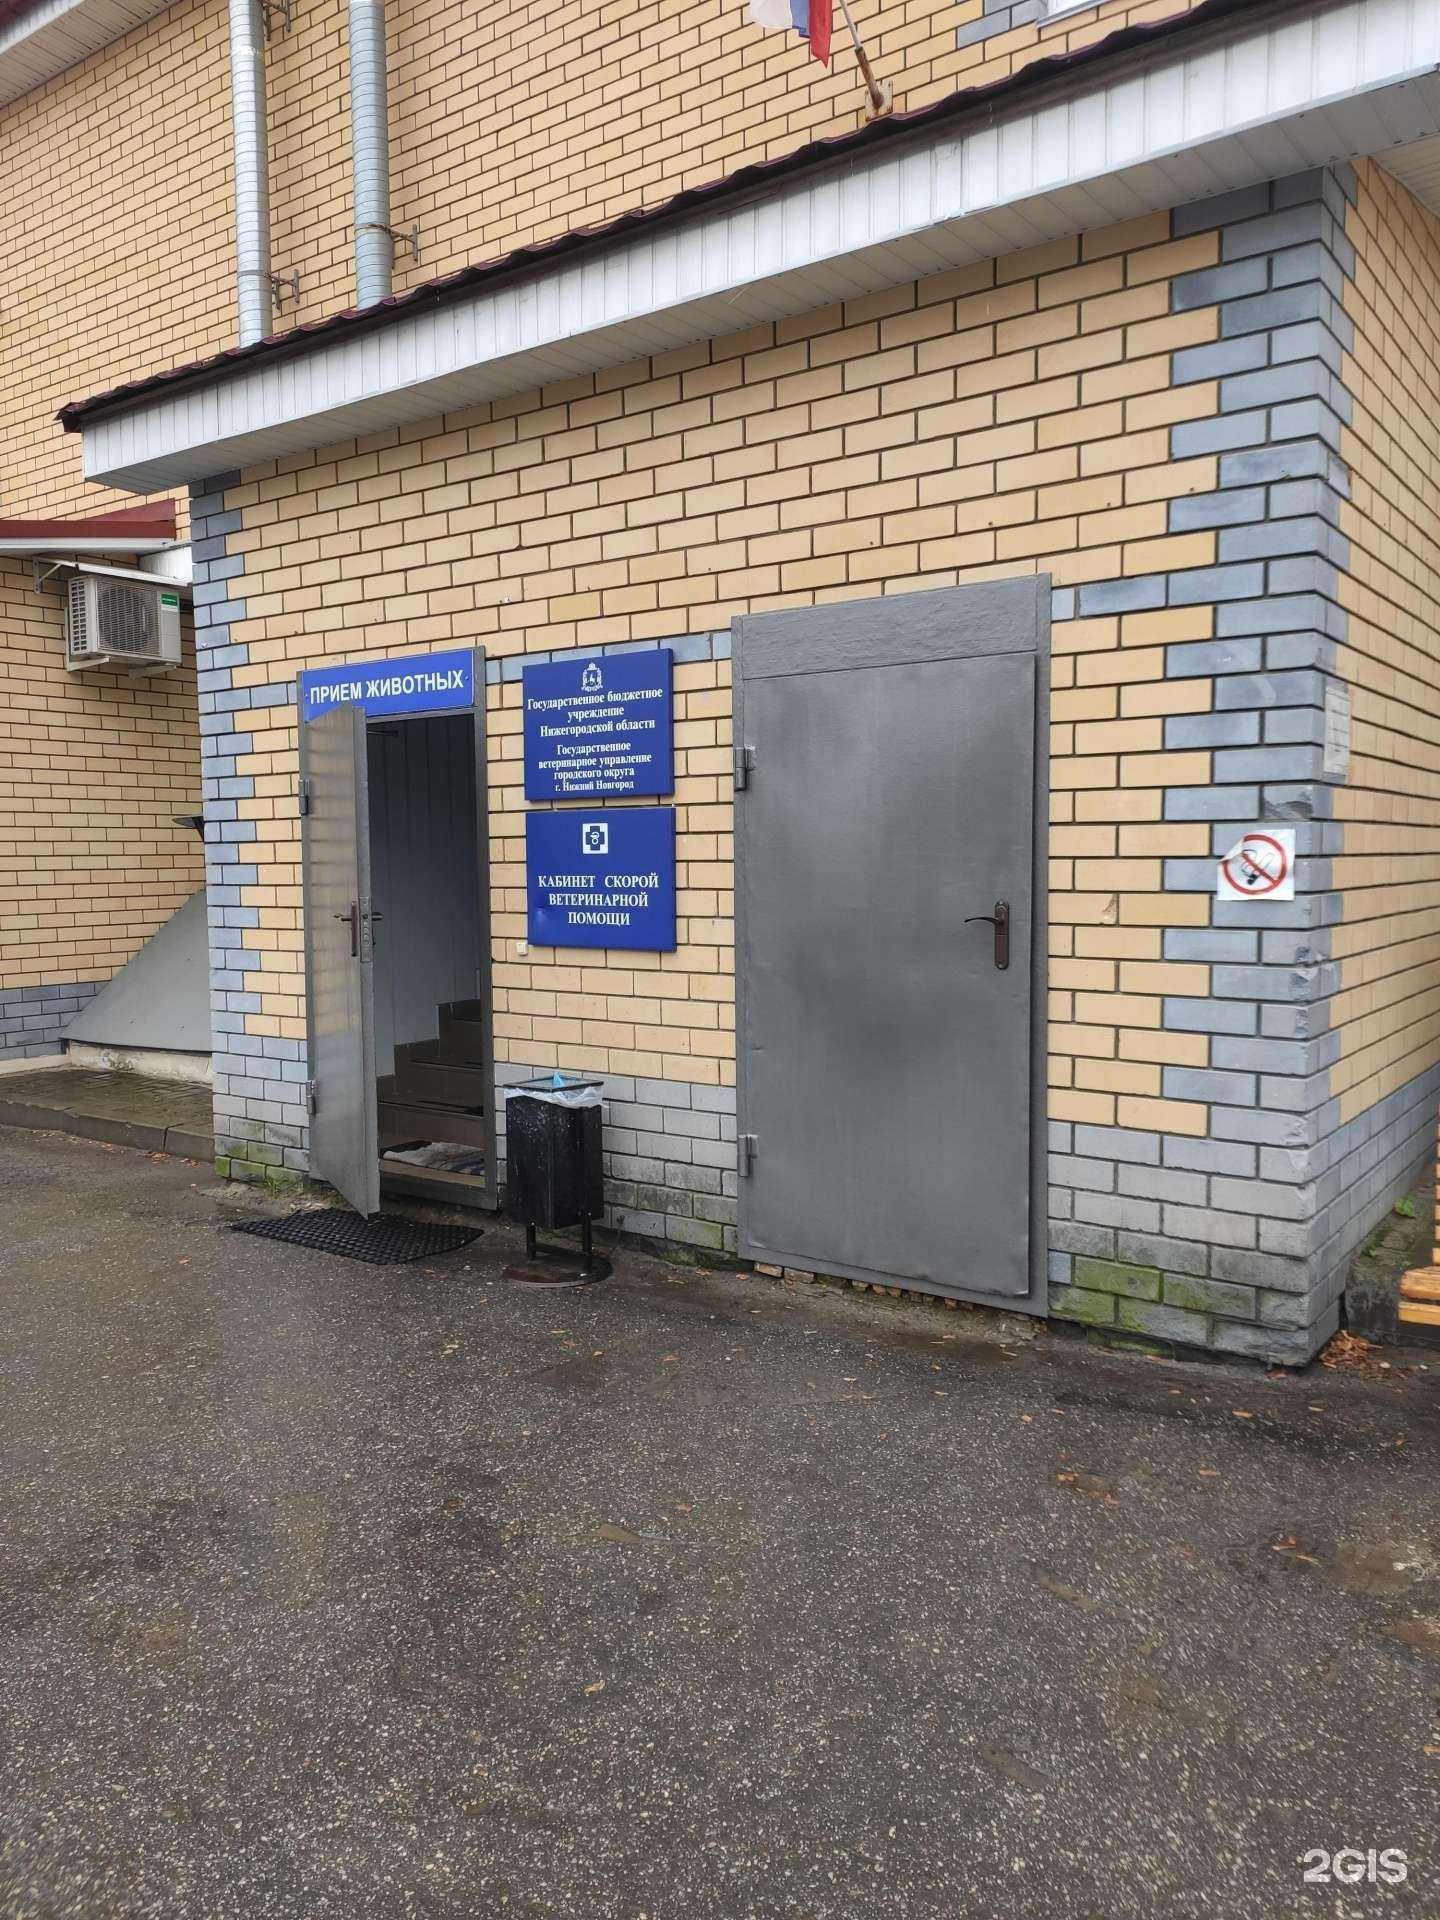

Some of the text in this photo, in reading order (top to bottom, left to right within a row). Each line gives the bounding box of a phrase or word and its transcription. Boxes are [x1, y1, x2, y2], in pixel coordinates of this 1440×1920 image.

[310, 669, 464, 704] ПРИЕМ ЖИВОТНЫХ
[527, 687, 663, 711] Государственное бюджетное
[567, 706, 625, 723] учреждение
[540, 719, 656, 737] Нижегородской области
[557, 742, 632, 757] Государственное
[538, 753, 652, 771] ветеринарное управление
[554, 766, 635, 781] городского округа
[563, 780, 594, 791] Нижний
[596, 780, 634, 791] Новгород
[538, 872, 659, 888] КАБИНЕТ СКОРОЙ
[549, 891, 649, 907] ВЕТЕРИНАРНОЙ
[568, 912, 631, 927] ПОМОЩИ
